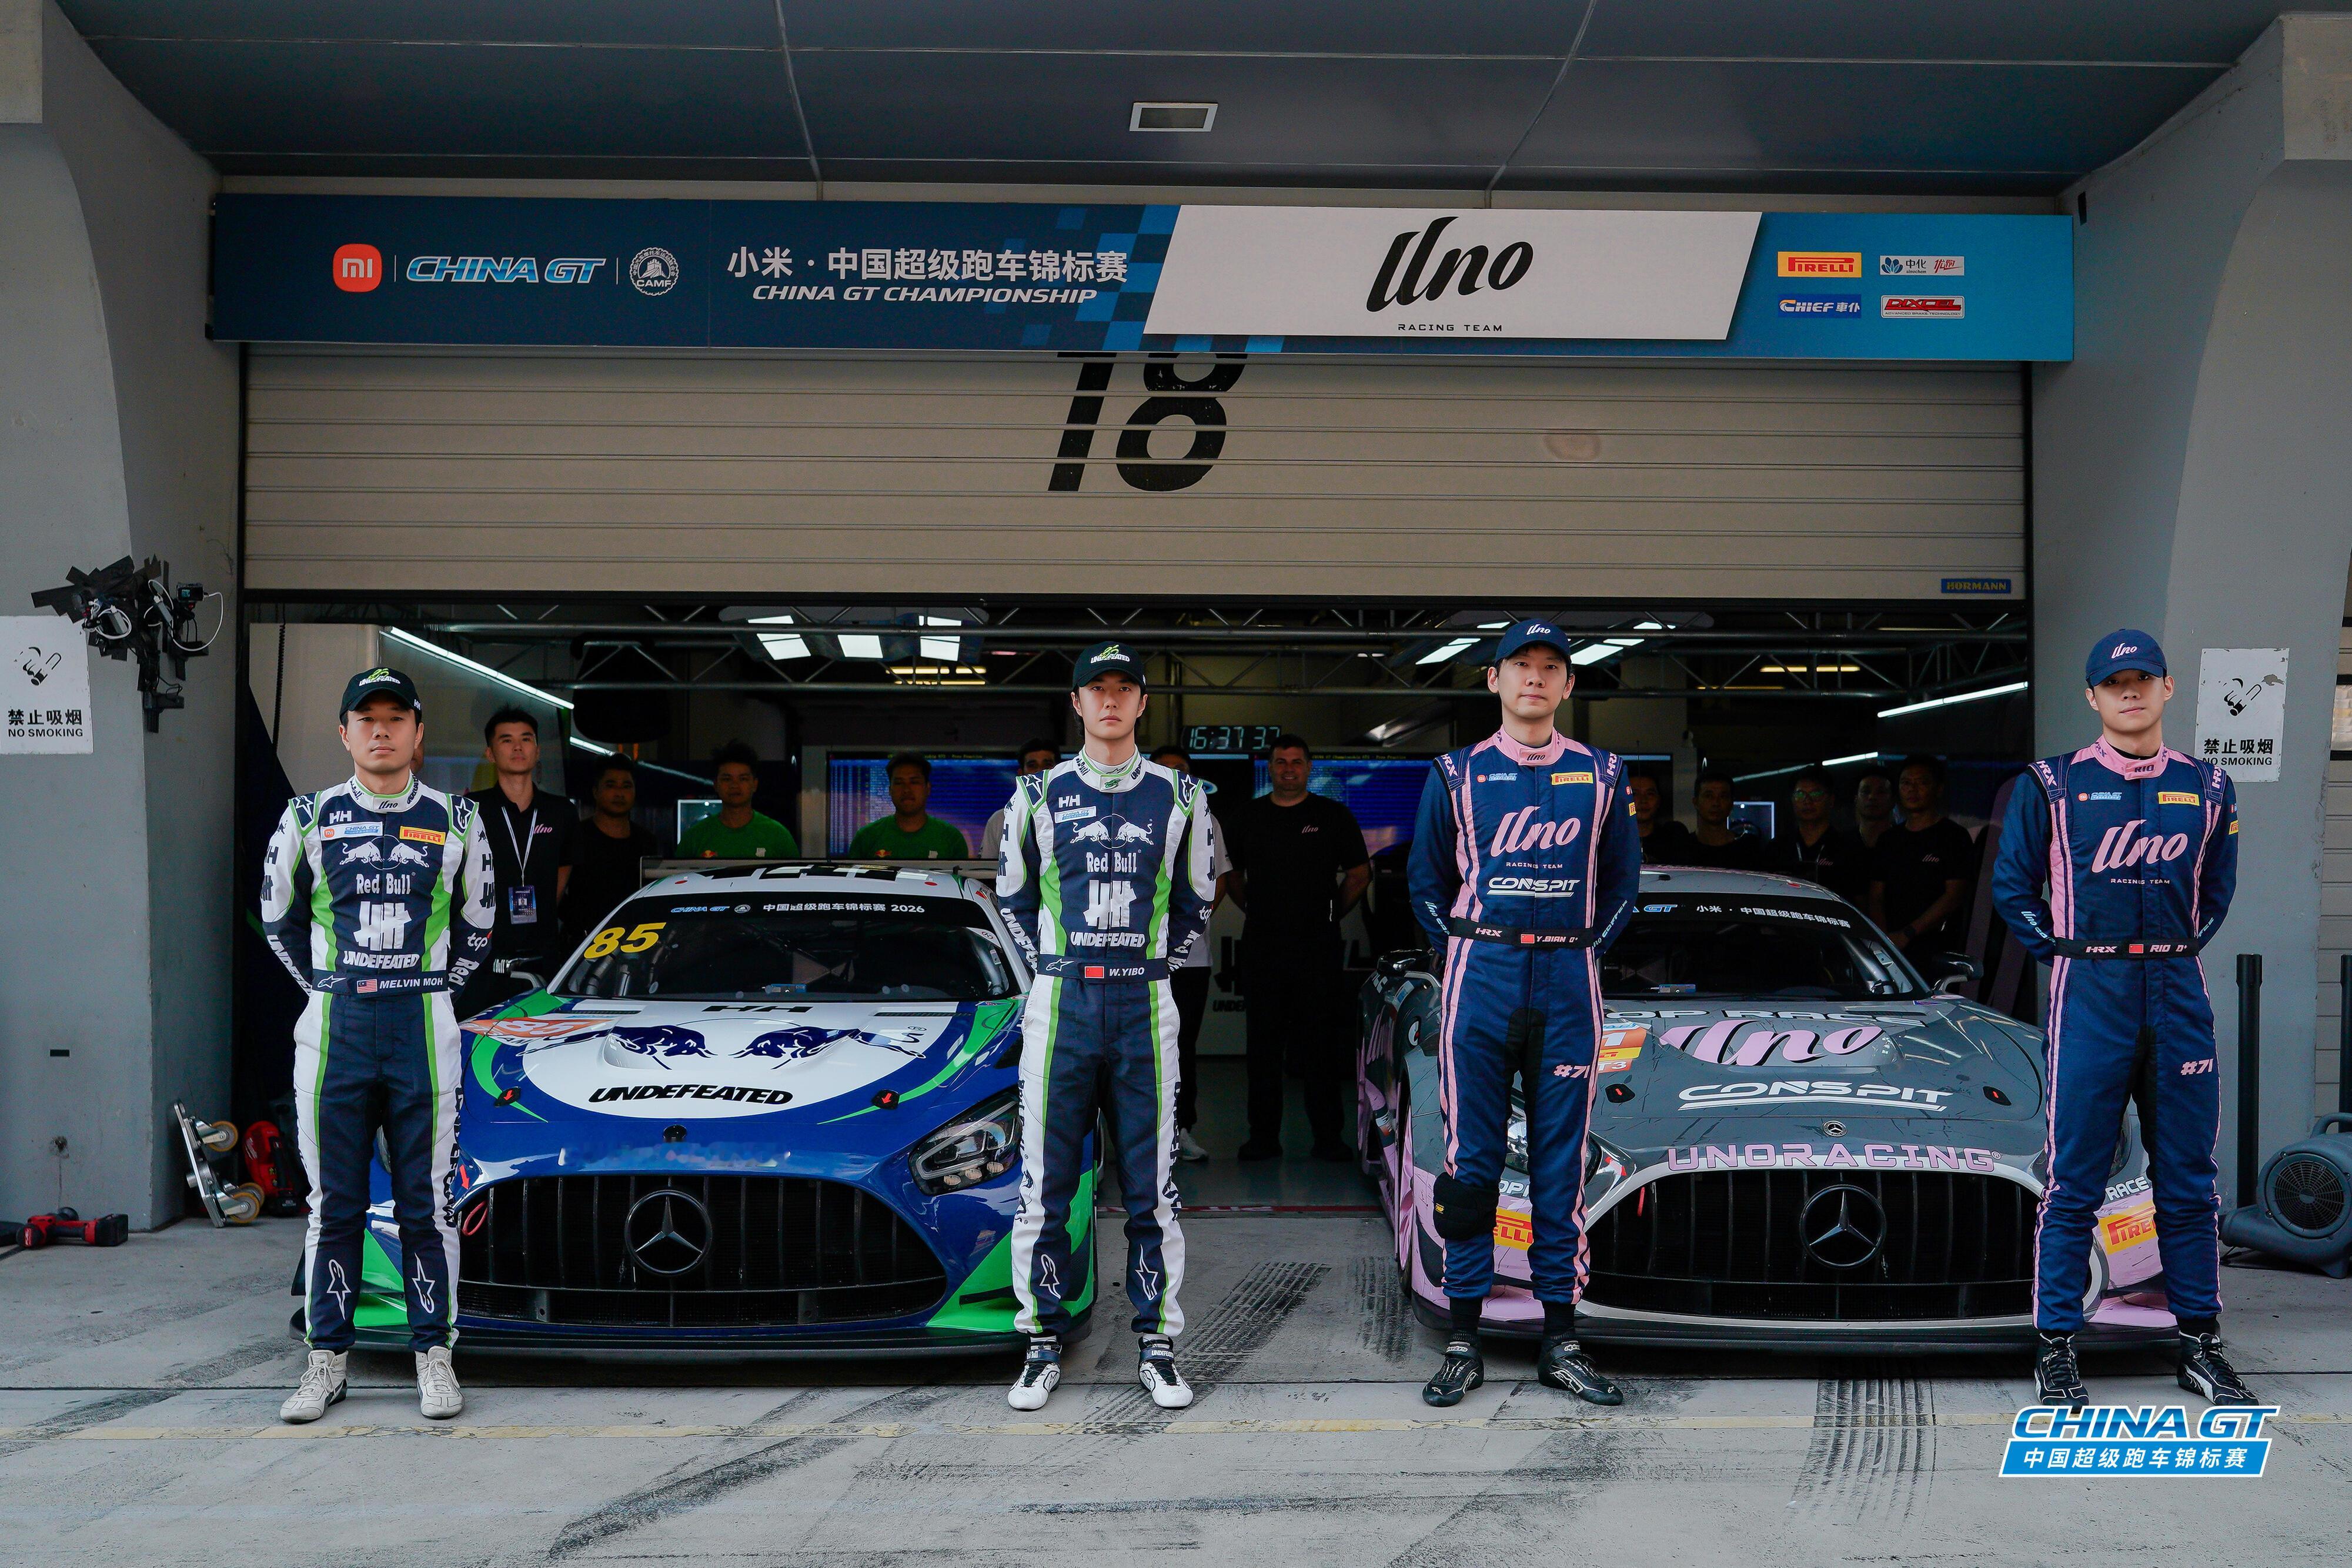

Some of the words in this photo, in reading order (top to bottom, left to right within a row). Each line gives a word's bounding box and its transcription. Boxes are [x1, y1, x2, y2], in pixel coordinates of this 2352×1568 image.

[406, 256, 539, 283] CHINA
[544, 258, 606, 284] GT
[1788, 256, 1855, 273] PIRELLI
[1905, 259, 1927, 269] 中化
[637, 279, 671, 287] CAMF
[753, 285, 836, 301] CHINA
[843, 286, 880, 302] GT
[884, 287, 1097, 304] CHAMPIONSHIP
[1779, 299, 1834, 313] CHIEF
[1883, 298, 1962, 312] DIXCEL
[1398, 323, 1455, 332] RACING
[1464, 325, 1503, 333] TEAM
[1048, 353, 1245, 492] 18
[8, 709, 82, 726] 禁止吸烟
[8, 728, 25, 737] NO
[28, 728, 83, 737] SMOKING
[2203, 738, 2274, 754] 禁止吸烟
[2203, 757, 2218, 765] NO
[2221, 757, 2272, 765] SMOKING
[1555, 774, 1589, 783] PIRELLI
[1058, 794, 1081, 808] HH
[2162, 794, 2196, 803] PIRELLI
[329, 810, 352, 824] HH
[403, 828, 442, 842] PIRELLI
[1085, 852, 1108, 873] Red
[1114, 852, 1138, 873] Bull
[356, 873, 380, 895] Red
[386, 874, 411, 895] Bull
[1488, 877, 1581, 892] CONSPIT
[763, 903, 886, 912] 中国超级跑车锦标赛
[891, 904, 926, 913] 2026
[1070, 931, 1145, 948] UNDEFEATED
[1475, 927, 1503, 938] HRX
[583, 921, 667, 960] 85
[2149, 944, 2171, 952] RIO
[2085, 945, 2117, 954] HRX
[342, 950, 420, 969] UNDEFEATED
[1108, 967, 1145, 977] W.YIBO
[379, 979, 420, 989] MELVIN
[423, 977, 443, 987] MOH
[1605, 1010, 1706, 1019] OP
[1723, 1009, 1927, 1028] RACE
[2180, 1058, 2213, 1075] #71
[589, 1084, 793, 1104] UNDEFEATED
[1678, 1080, 1954, 1104] CONSPIT
[1667, 1142, 1996, 1172] UNORACING
[2105, 1176, 2150, 1201] RACE
[2107, 1206, 2157, 1246] PIRE
